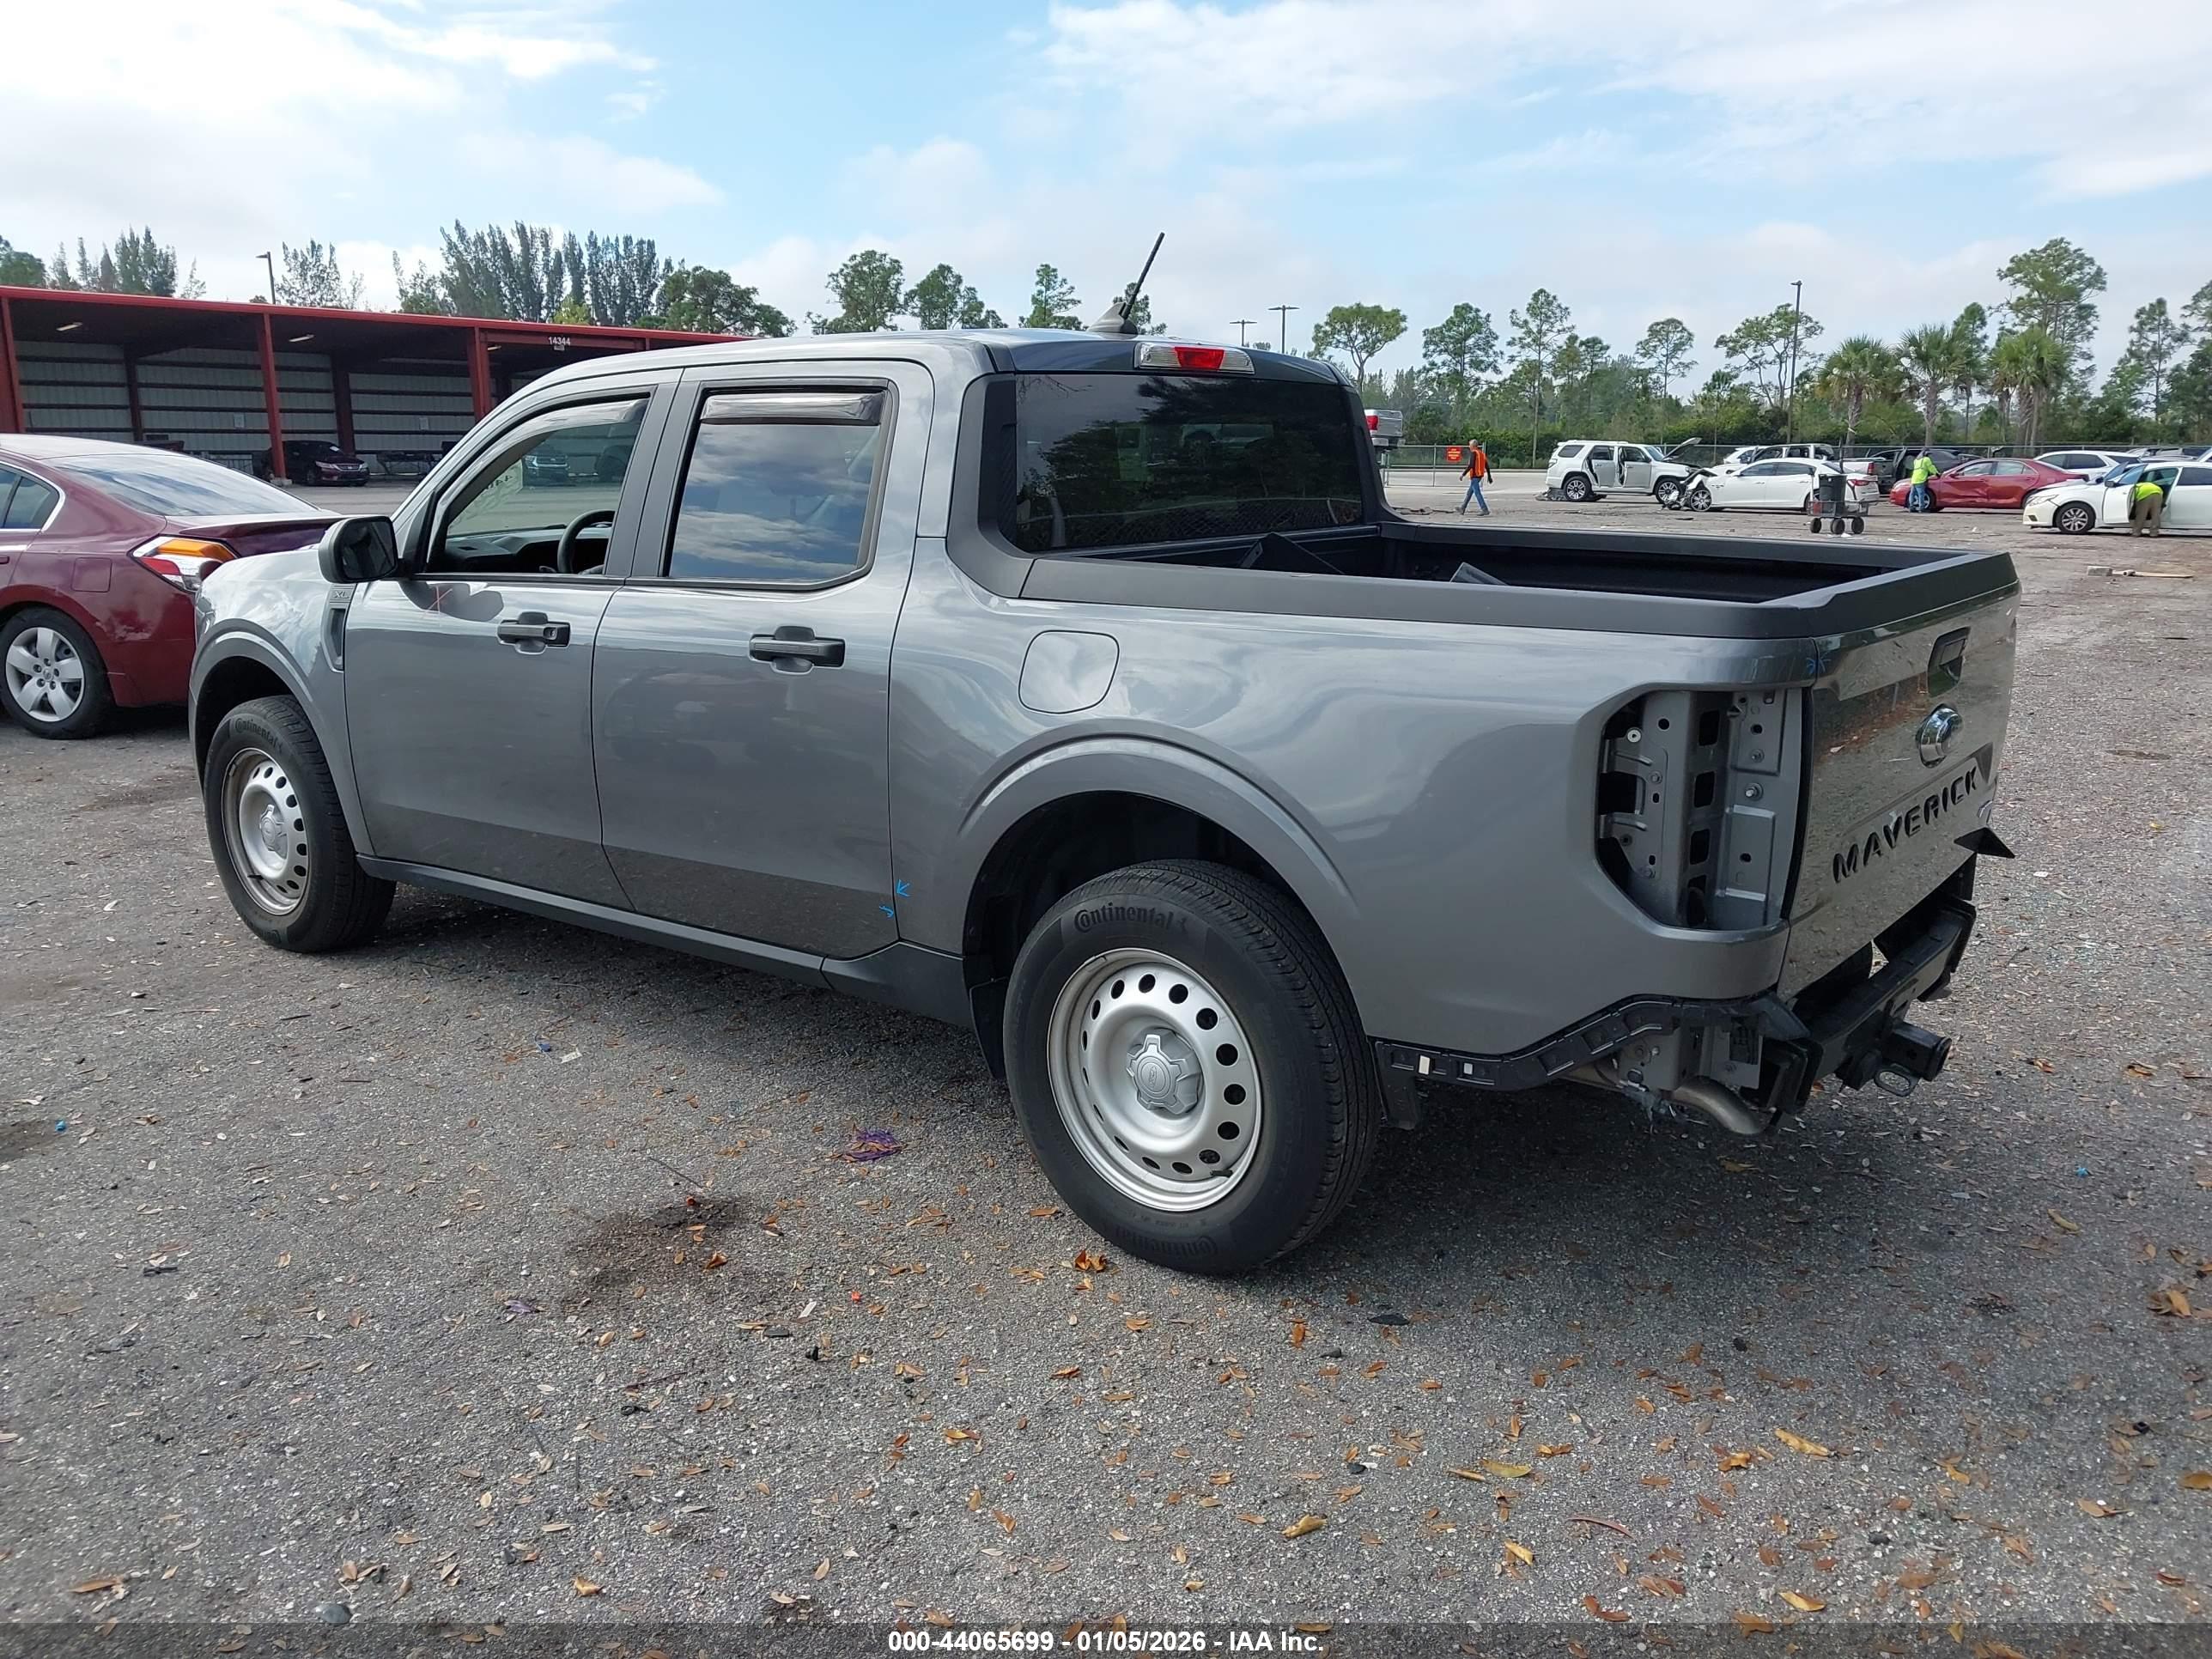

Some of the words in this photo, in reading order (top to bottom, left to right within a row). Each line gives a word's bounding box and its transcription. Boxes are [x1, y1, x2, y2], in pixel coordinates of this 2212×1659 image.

[548, 336, 571, 346] 14344
[335, 590, 349, 599] XL
[1832, 766, 1977, 884] MAVERICK
[1074, 902, 1174, 933] Continental
